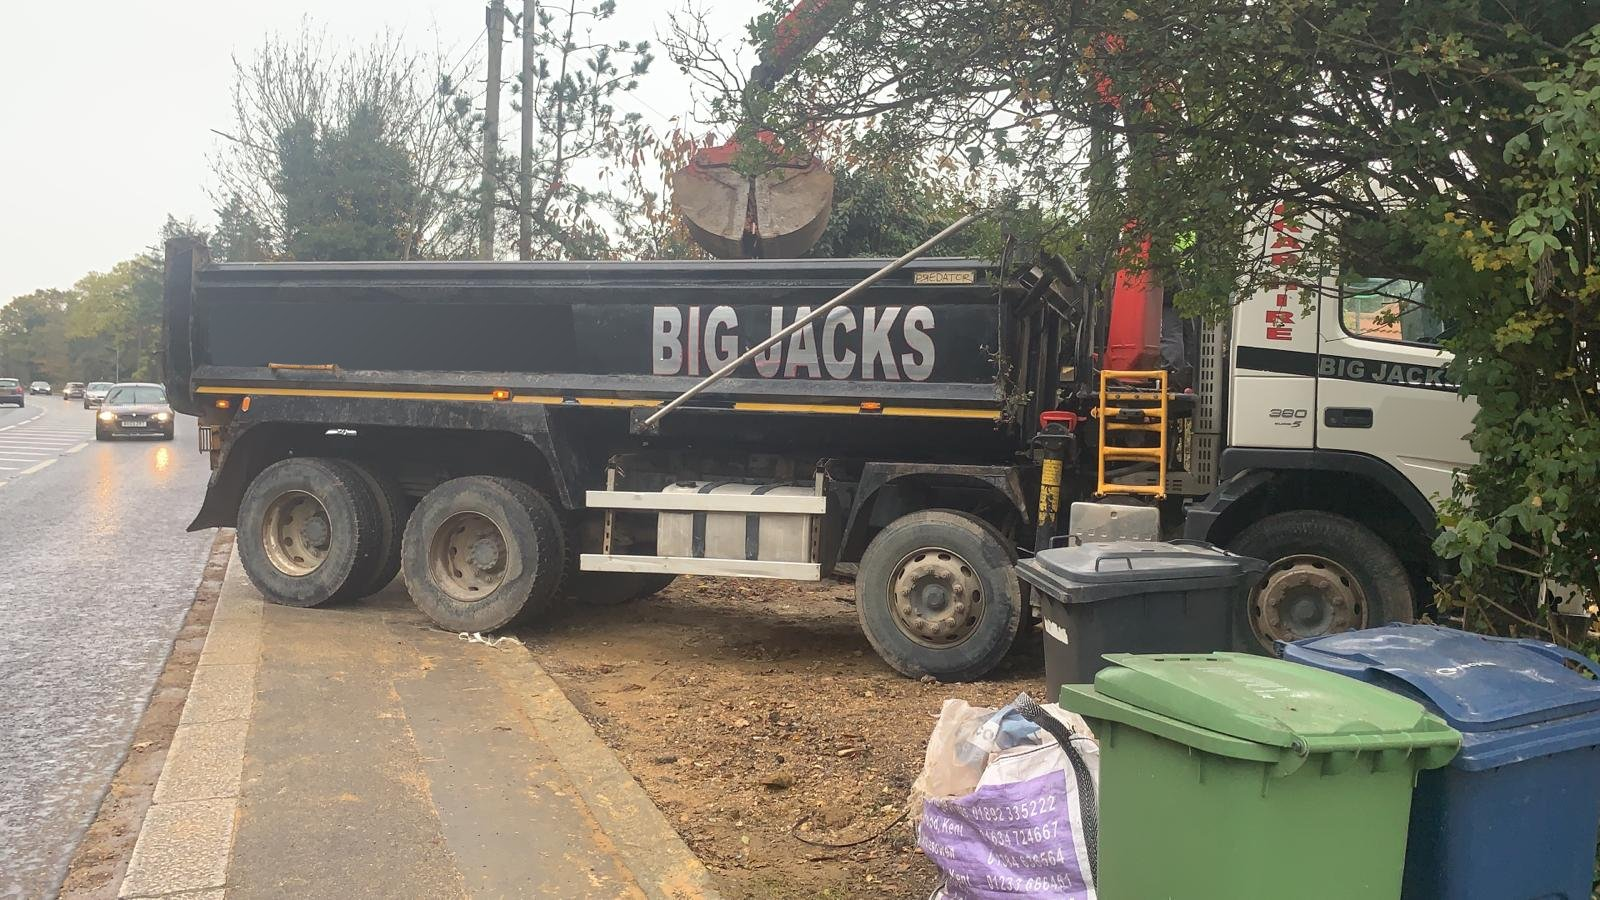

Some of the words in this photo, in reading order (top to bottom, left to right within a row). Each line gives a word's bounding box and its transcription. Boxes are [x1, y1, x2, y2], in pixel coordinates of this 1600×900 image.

[652, 304, 740, 378] BIG
[753, 304, 936, 382] JACKS
[1319, 357, 1366, 379] BIG
[1371, 363, 1452, 386] JACK
[1269, 408, 1308, 418] 380
[1006, 795, 1056, 821] 335222
[942, 818, 963, 837] Kent
[1012, 820, 1058, 845] 724667
